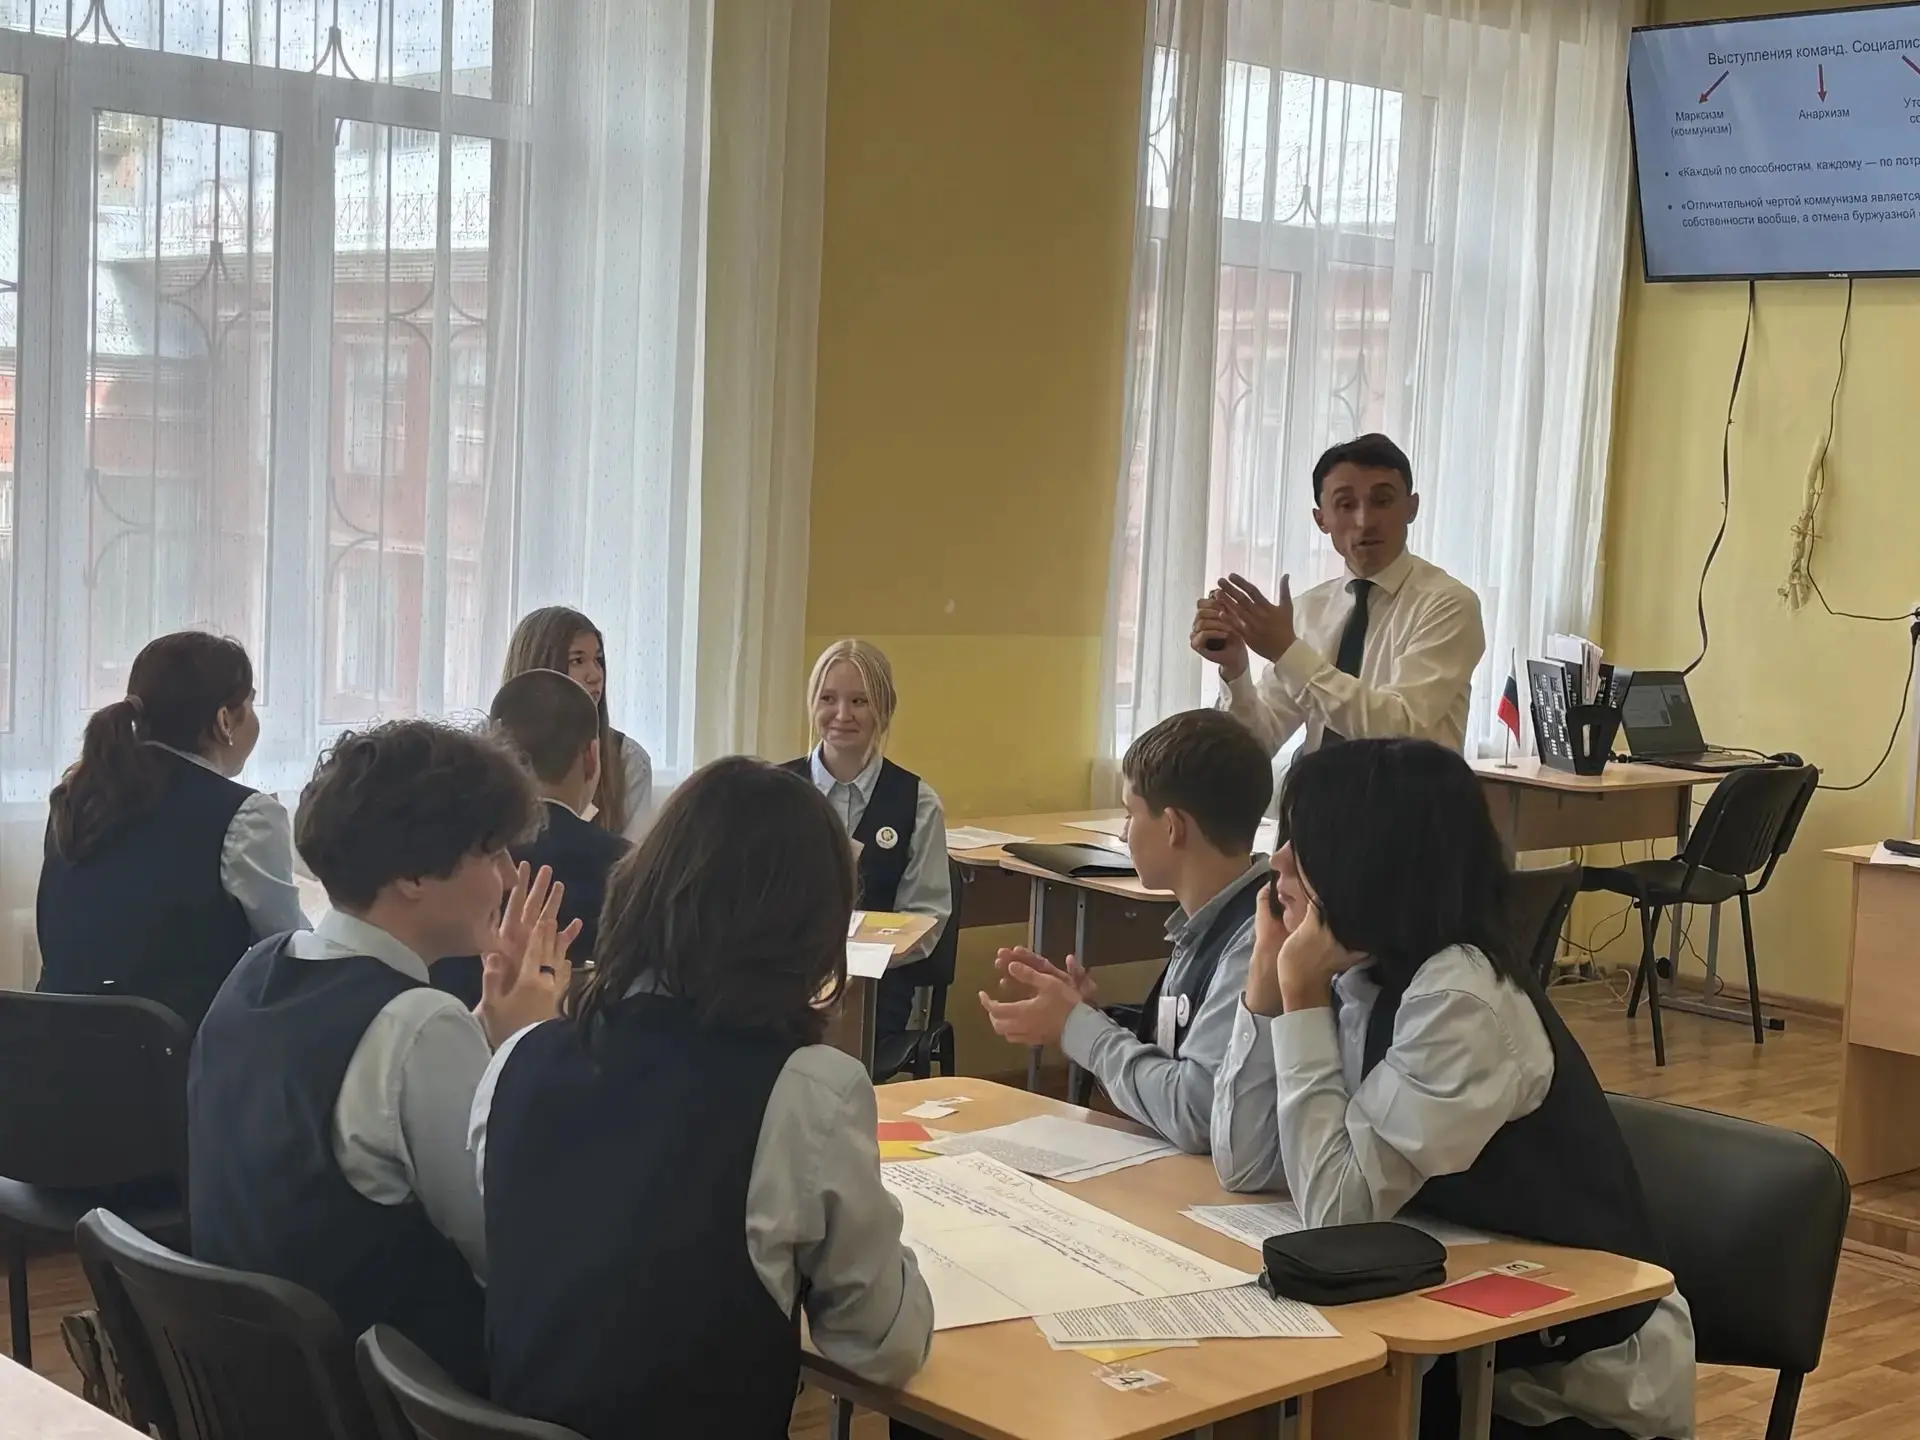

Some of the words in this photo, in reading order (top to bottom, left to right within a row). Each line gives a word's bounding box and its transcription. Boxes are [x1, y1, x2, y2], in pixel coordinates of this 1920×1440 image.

[1708, 48, 1793, 66] Выступления
[1796, 44, 1848, 58] команд.
[1852, 38, 1920, 53] Социалис
[1675, 111, 1725, 123] Марксизм
[1799, 109, 1850, 121] Анархизм
[1670, 122, 1732, 139] (коммунизм)
[1678, 165, 1722, 177] «Каждый
[1725, 166, 1737, 175] по
[1816, 159, 1862, 171] каждому
[1880, 157, 1893, 167] по
[1681, 196, 1764, 211] «Отличительной
[1765, 195, 1801, 208] чертой
[1804, 194, 1868, 206] коммунизма
[1871, 192, 1920, 203] является
[1682, 216, 1755, 228] собственности
[1757, 213, 1800, 225] вообще,
[1802, 214, 1809, 222] а
[1812, 212, 1850, 222] отмена
[1852, 208, 1916, 224] буржуазной
[1118, 1377, 1146, 1386] 4
